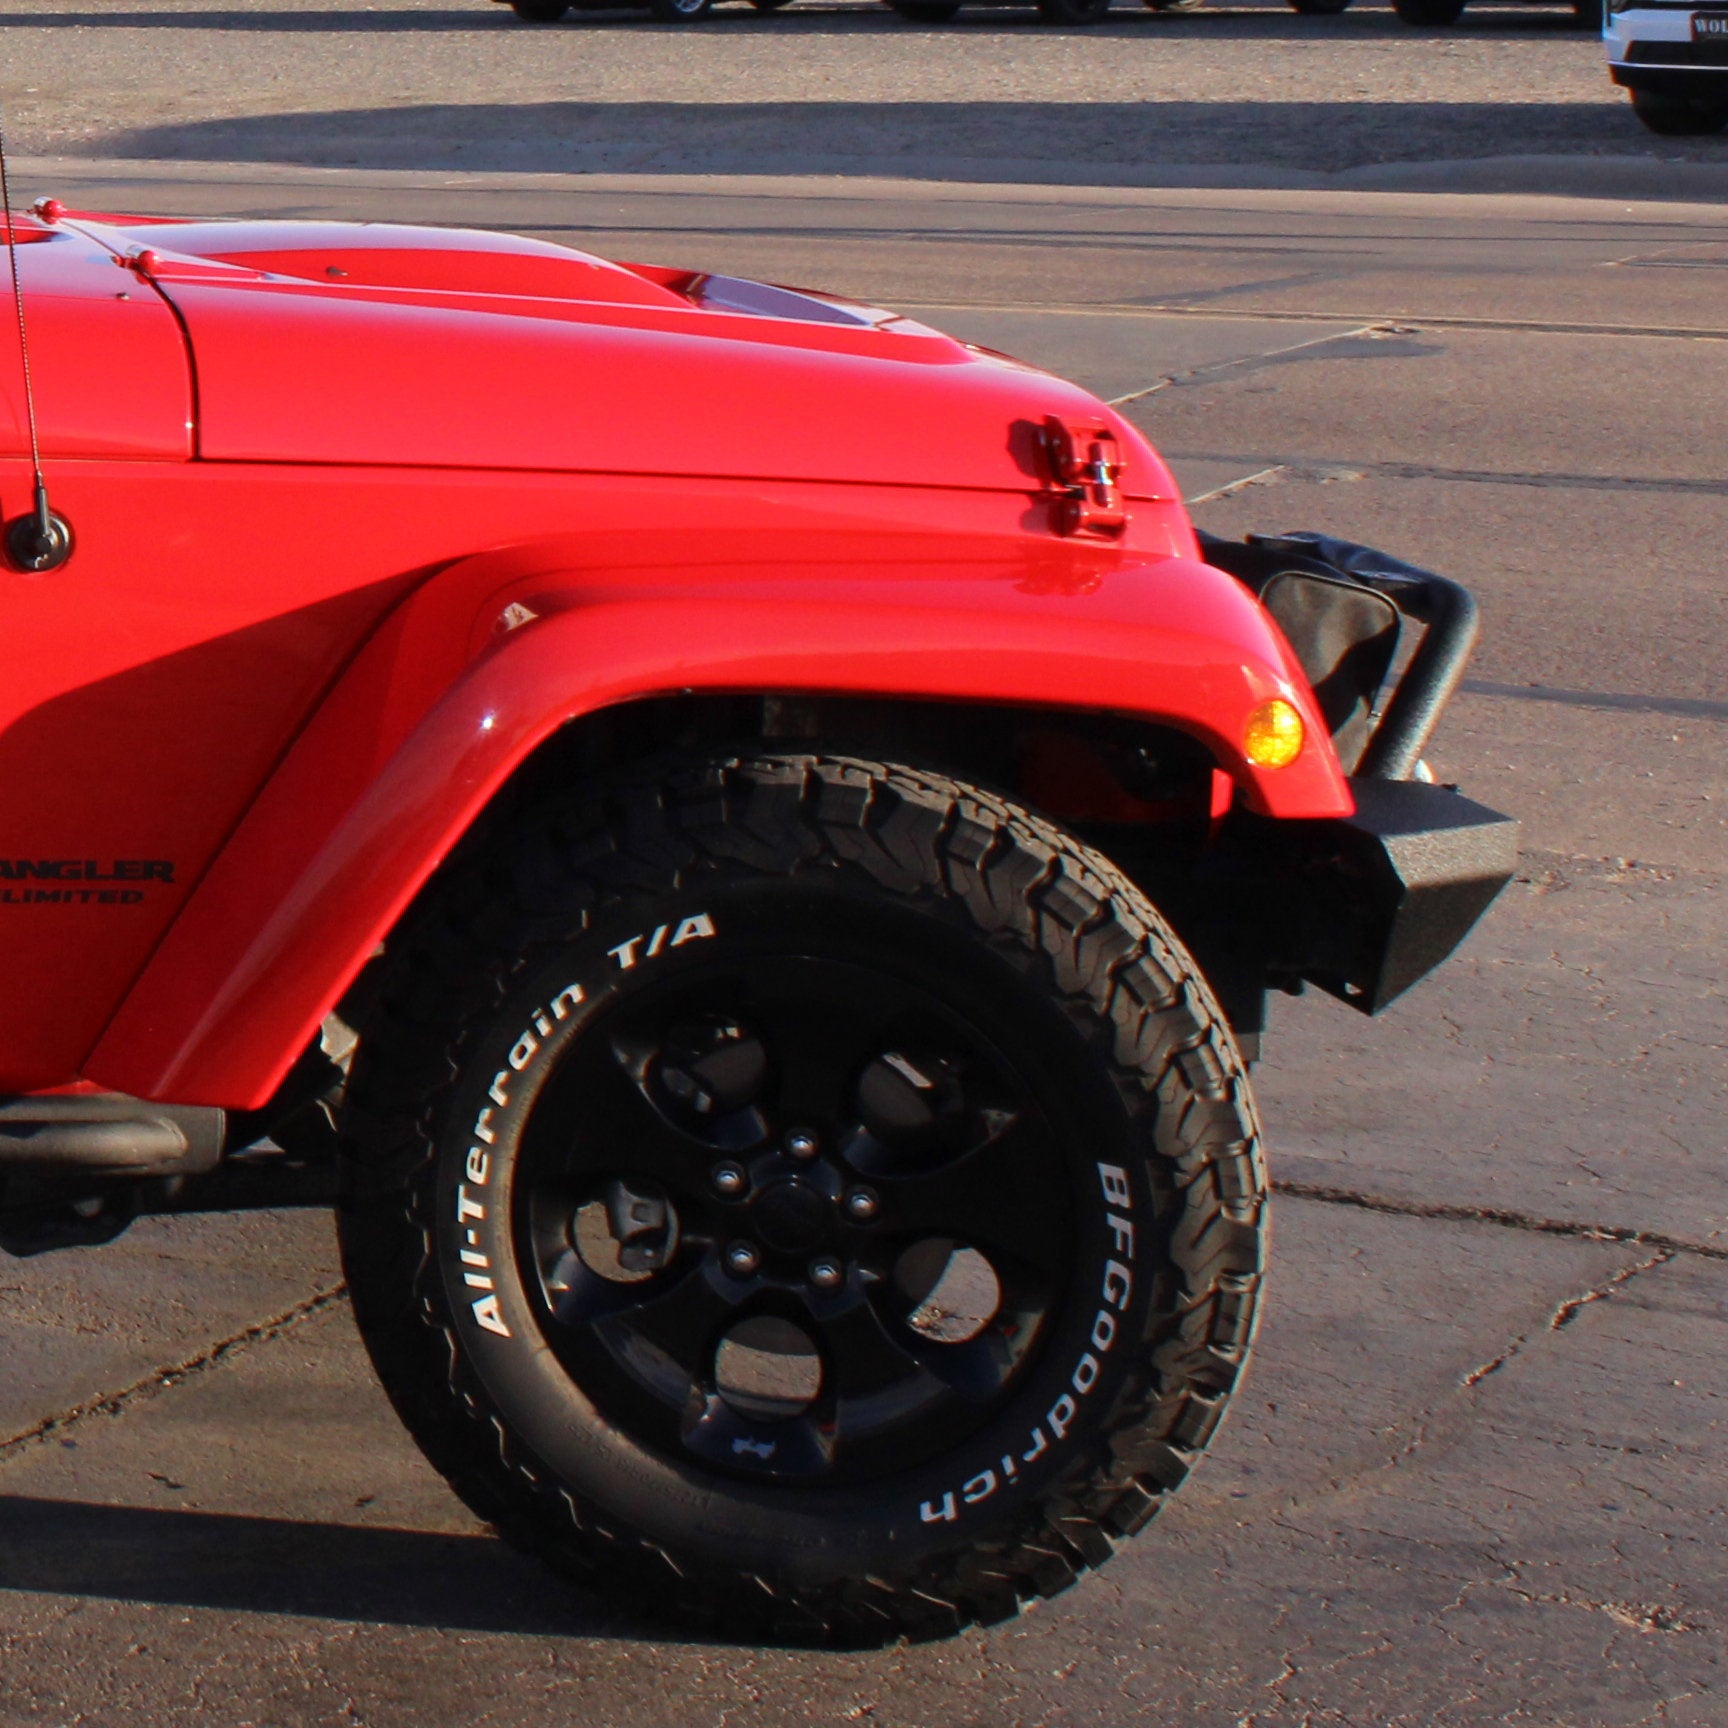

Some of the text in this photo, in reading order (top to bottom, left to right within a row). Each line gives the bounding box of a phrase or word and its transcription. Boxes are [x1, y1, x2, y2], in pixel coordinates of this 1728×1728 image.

[456, 912, 718, 1339] All-Terrain T/A
[919, 1160, 1137, 1524] BFGoodrich
